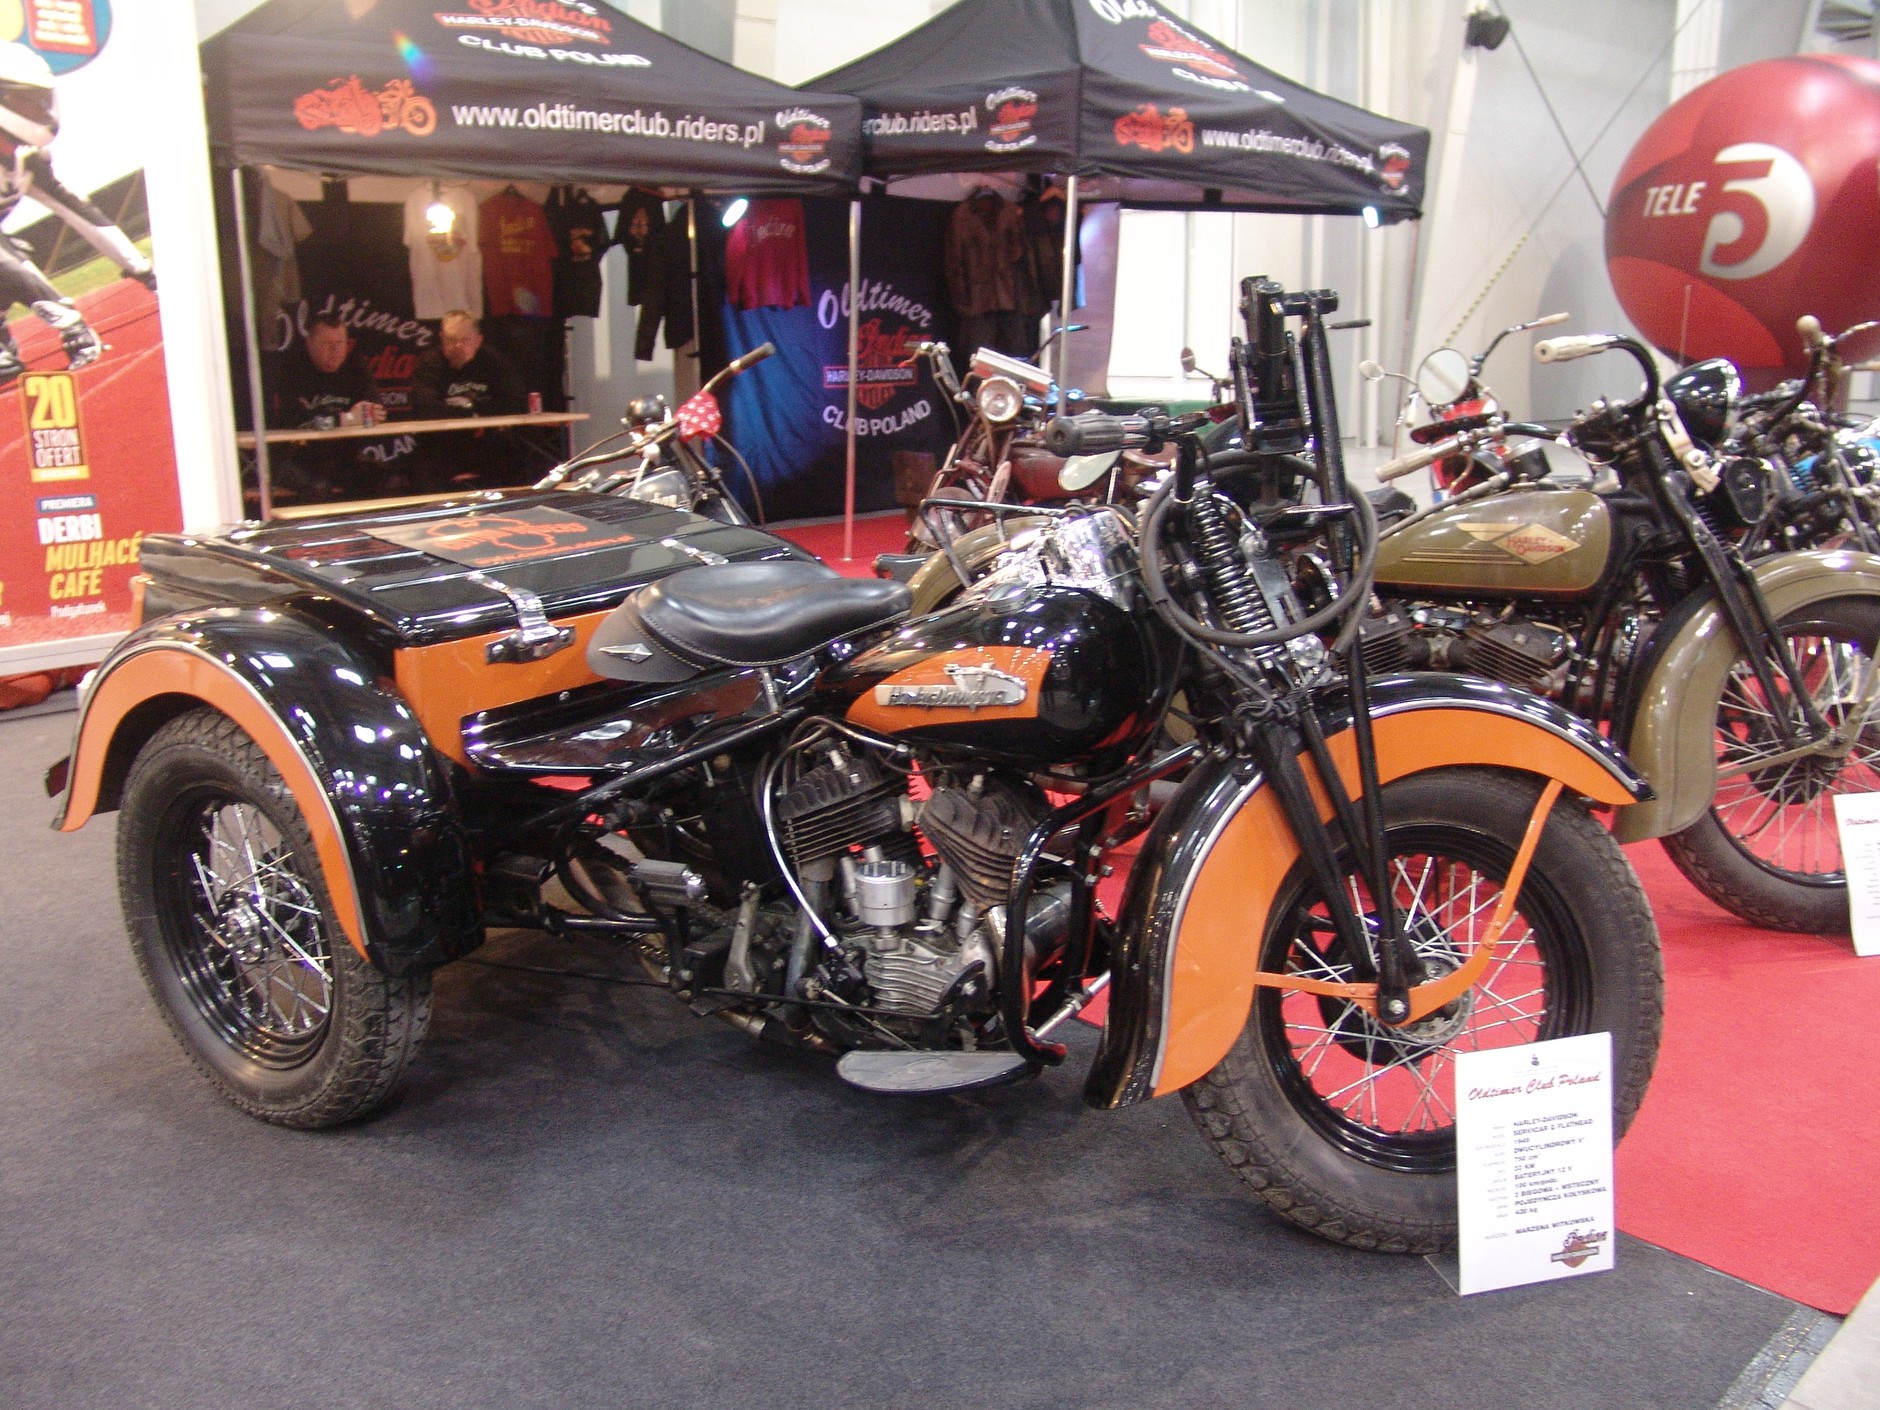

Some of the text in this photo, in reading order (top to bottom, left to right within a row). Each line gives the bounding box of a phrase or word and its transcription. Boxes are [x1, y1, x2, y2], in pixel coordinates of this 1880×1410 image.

[458, 34, 652, 67] CLUB POLAND
[451, 102, 765, 148] www.oldtimerclub.riders.pl
[1643, 142, 1817, 280] TELE 5
[825, 368, 914, 384] HAREY-DAVIDSON
[24, 375, 78, 429] 20
[869, 399, 932, 436] POLAND
[34, 446, 81, 468] OFERT
[37, 512, 104, 544] DERBI
[1468, 1086, 1522, 1101] Oldtimer
[1526, 1076, 1556, 1094] Club
[1558, 1070, 1602, 1087] Poland
